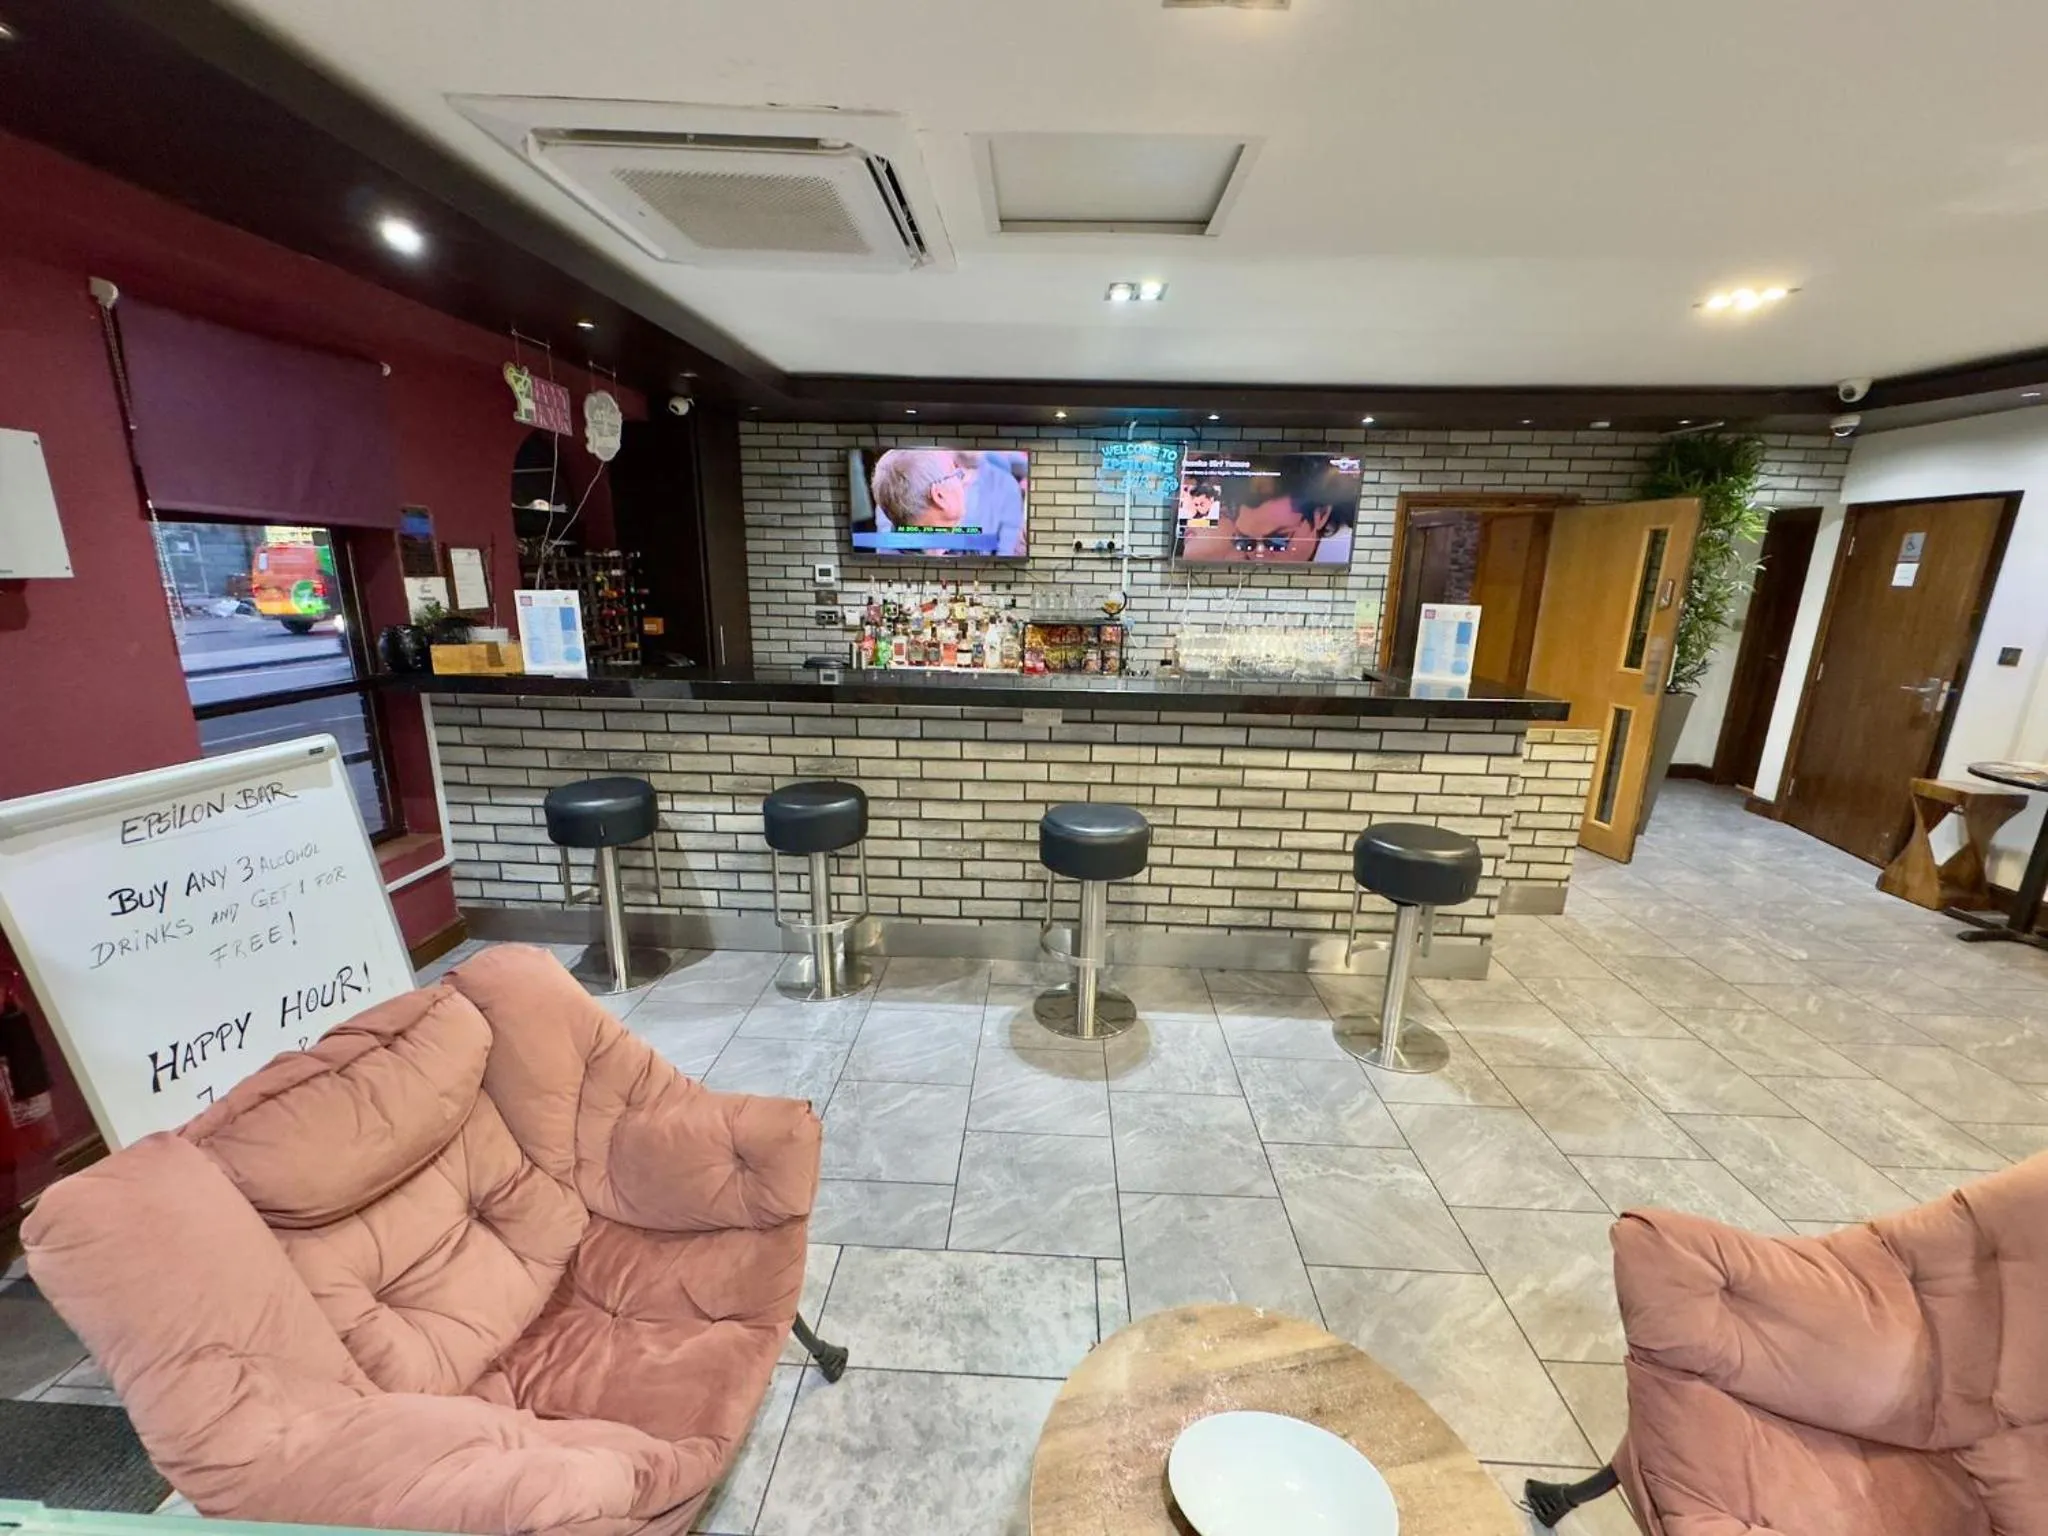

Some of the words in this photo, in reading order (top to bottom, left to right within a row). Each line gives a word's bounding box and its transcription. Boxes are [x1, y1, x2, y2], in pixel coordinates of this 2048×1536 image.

[1102, 443, 1160, 458] WELCOME
[1161, 448, 1178, 461] TO
[234, 781, 298, 810] BAR
[108, 879, 169, 917] BUY
[185, 864, 228, 897] ANY
[236, 856, 254, 883] 3
[260, 843, 320, 872] ALCOHOL
[211, 902, 240, 926] AND
[250, 882, 292, 909] GET
[314, 865, 347, 888] FOR
[208, 910, 298, 969] FREE!
[148, 1011, 252, 1094] HAPPY
[280, 961, 371, 1028] HOUR!
